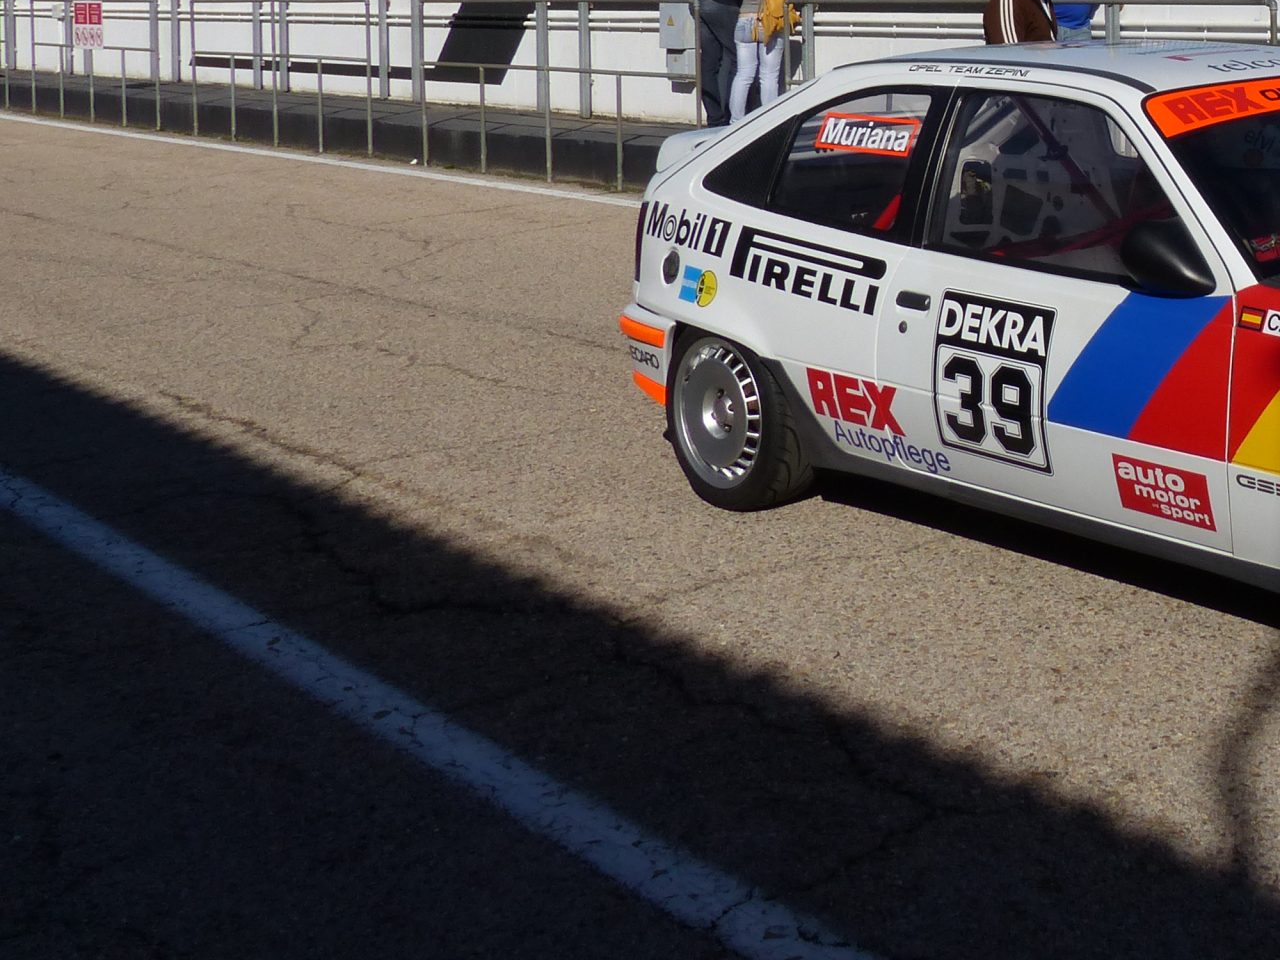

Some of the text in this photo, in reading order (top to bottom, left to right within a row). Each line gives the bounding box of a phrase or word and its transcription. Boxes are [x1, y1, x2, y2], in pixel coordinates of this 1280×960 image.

[908, 64, 943, 73] OPEL
[949, 65, 983, 75] TEAM
[1163, 86, 1269, 126] REX
[820, 117, 911, 152] Muriana
[646, 200, 708, 251] Mobil
[729, 224, 887, 316] PIRELLI
[938, 298, 1046, 357] DEKRA
[806, 367, 906, 437] REX
[942, 353, 1037, 459] 39
[834, 420, 952, 473] Autopflege
[1117, 461, 1185, 492] auto
[1134, 482, 1201, 510] motor
[1161, 504, 1211, 526] sport
